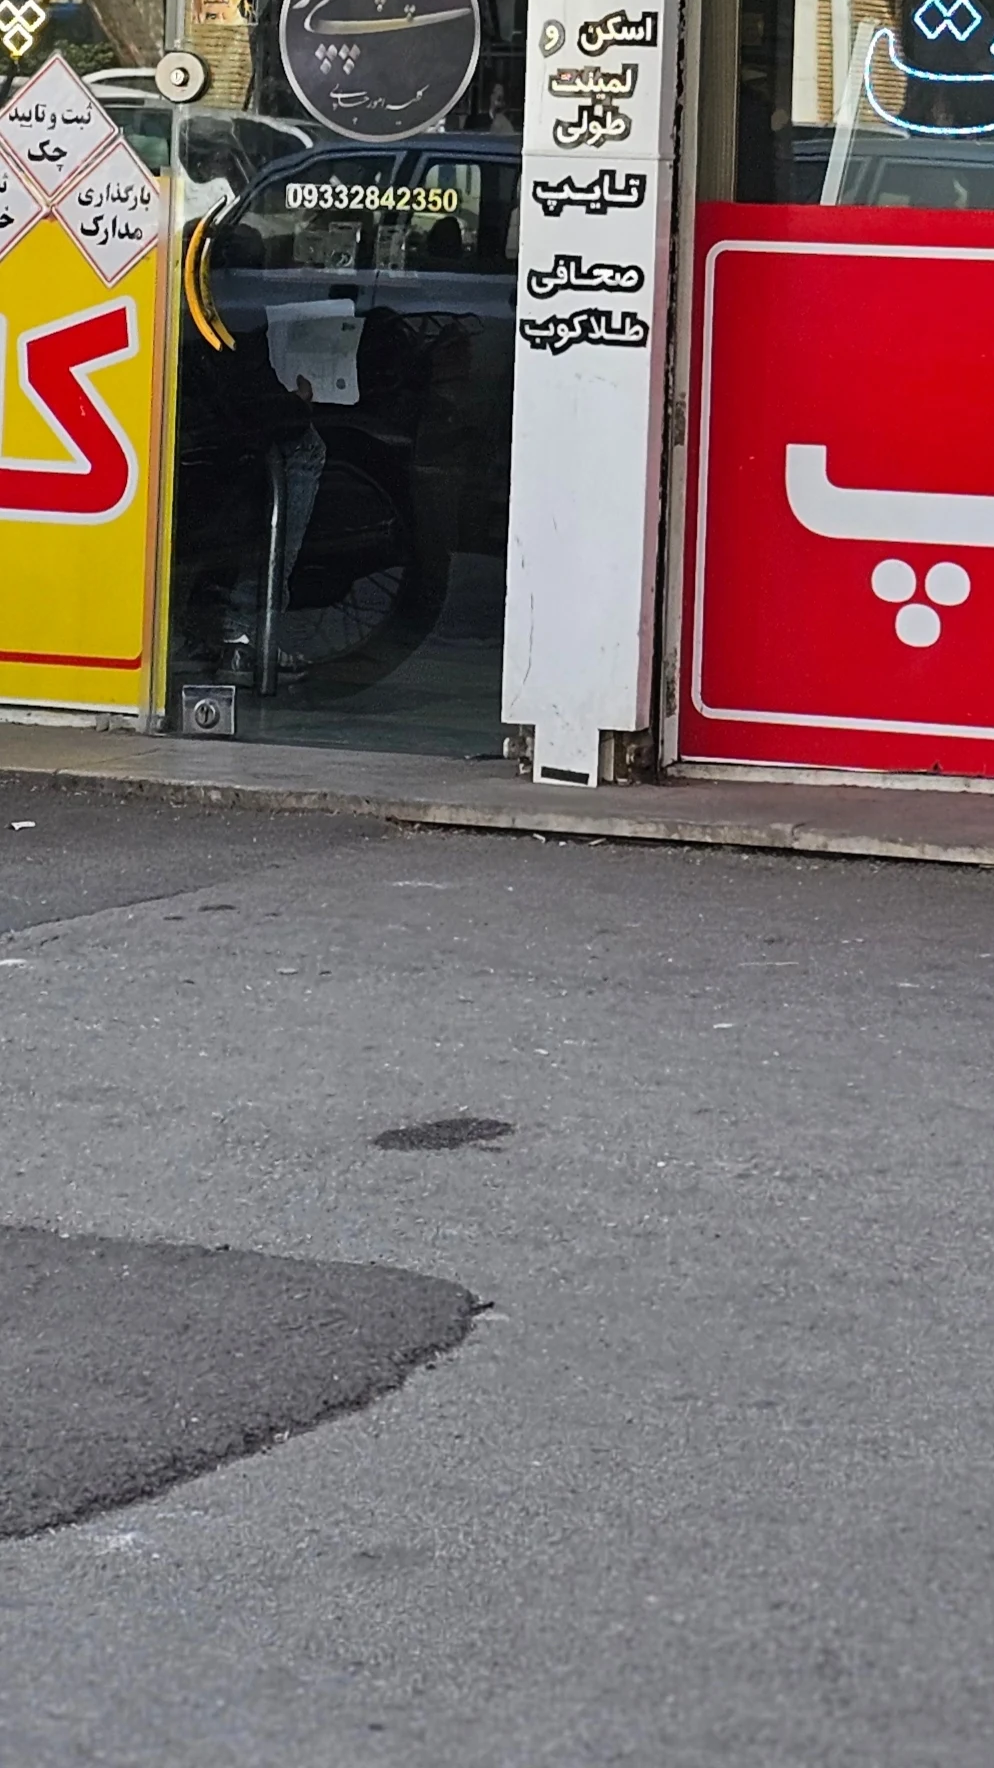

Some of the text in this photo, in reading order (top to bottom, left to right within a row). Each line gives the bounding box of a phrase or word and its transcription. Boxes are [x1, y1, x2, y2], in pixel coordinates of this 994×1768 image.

[539, 10, 658, 57] اسکن و
[549, 63, 638, 104] لمینت
[8, 102, 93, 131] ثبت و تایید
[553, 104, 632, 149] طولی
[27, 139, 68, 172] چک
[77, 183, 151, 212] بارگذاری
[286, 182, 458, 212] 09332842350
[532, 169, 646, 216] تایپ
[80, 215, 143, 246] مدارک
[527, 255, 644, 298] صحافی
[520, 307, 648, 355] طلاکوب
